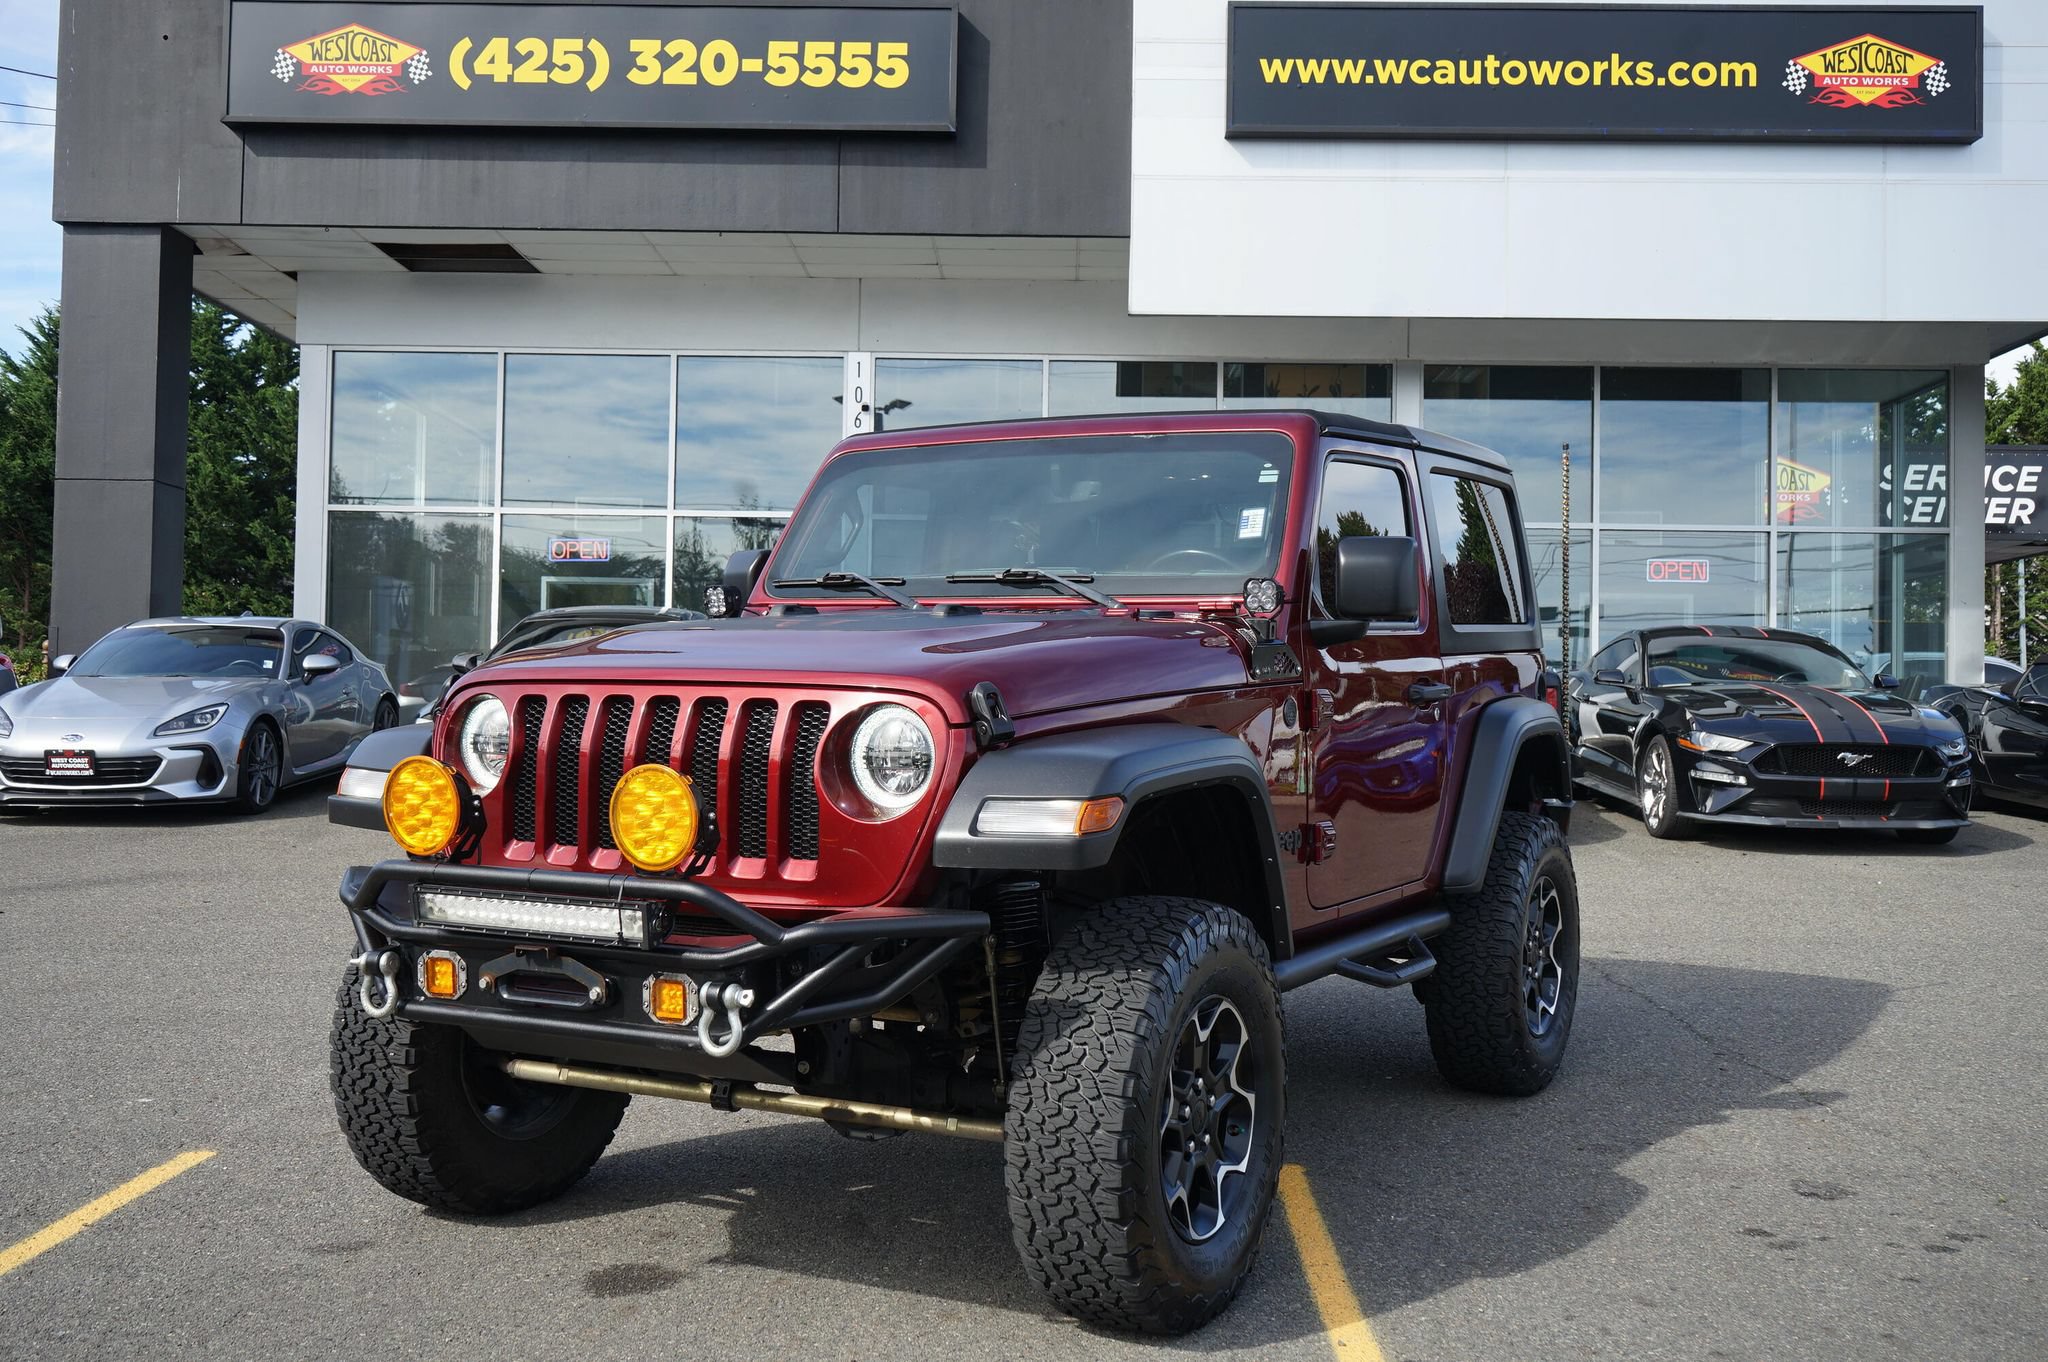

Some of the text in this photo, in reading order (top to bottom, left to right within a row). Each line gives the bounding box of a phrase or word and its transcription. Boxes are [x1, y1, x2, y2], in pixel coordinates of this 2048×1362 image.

[310, 65, 393, 74] AUTO WORKS
[448, 36, 910, 92] (425) 320-5555
[1259, 53, 1757, 87] www.wcautoworks.com
[1823, 77, 1909, 86] AUTO WORKS
[1777, 463, 1816, 491] OAST
[1879, 464, 2043, 493] SERICE
[1777, 494, 1811, 502] ORKS
[1886, 496, 2036, 525] CEER
[552, 541, 607, 559] OPEN
[1650, 561, 1707, 580] OPEN
